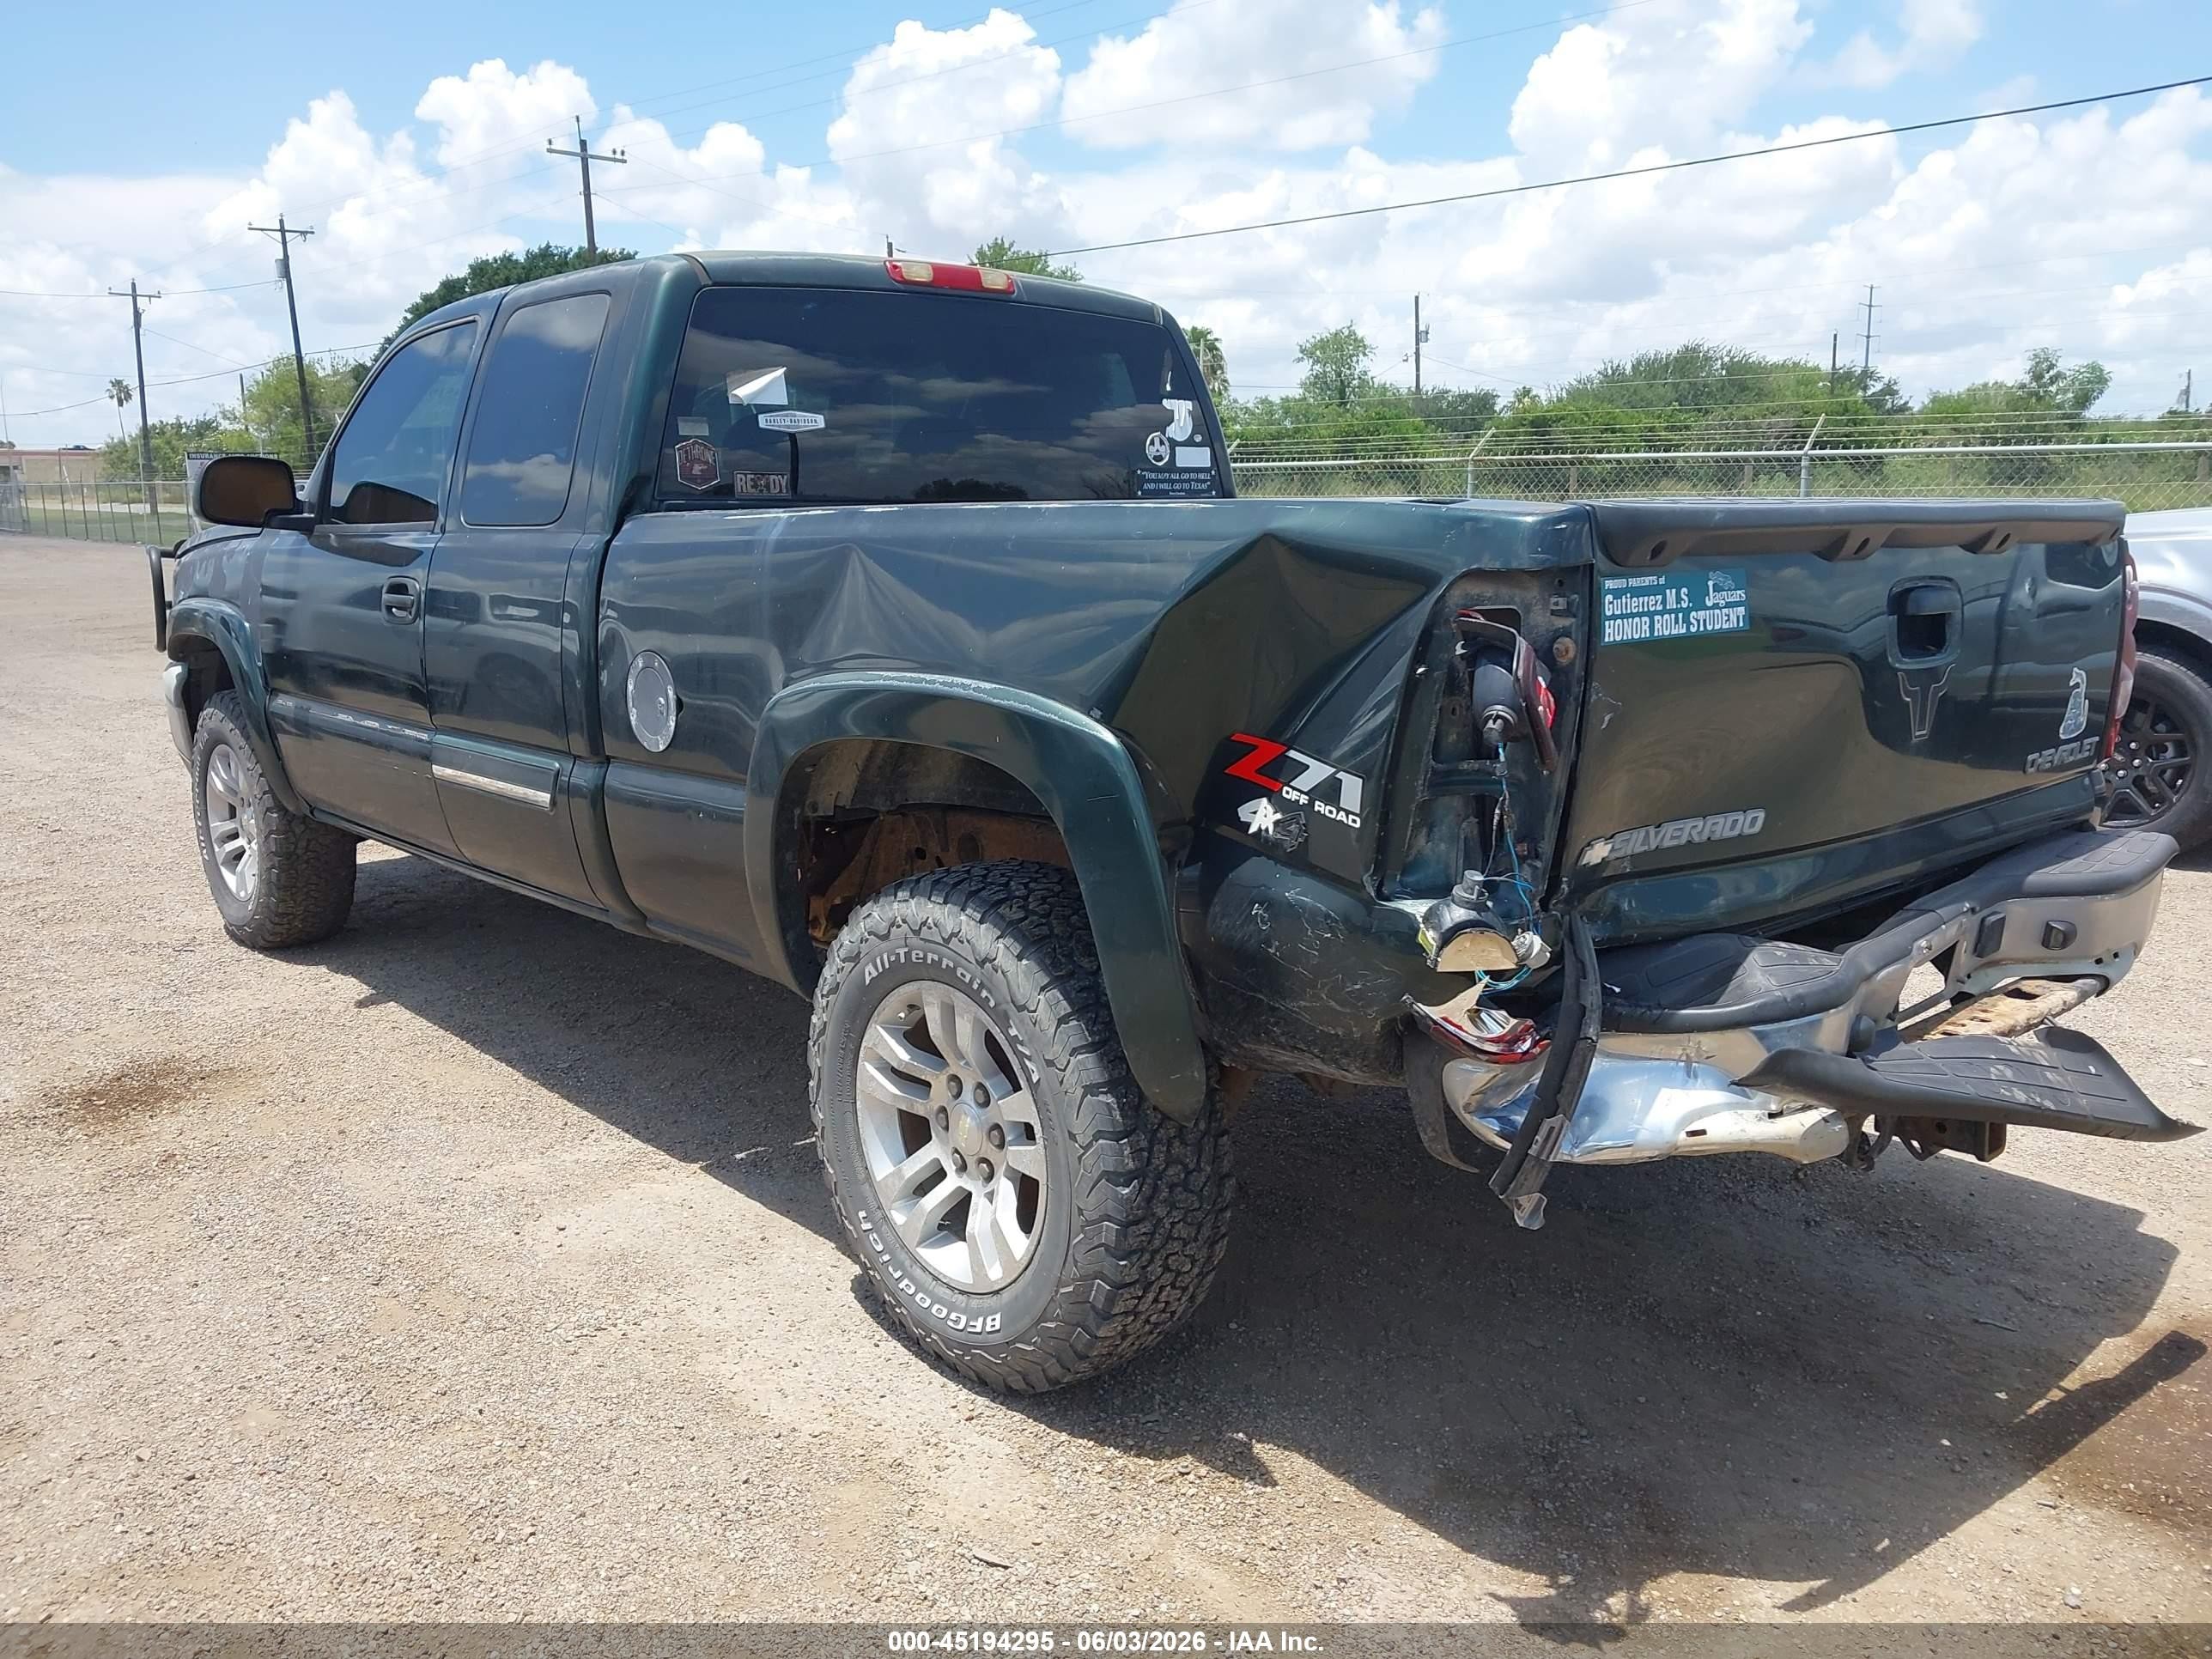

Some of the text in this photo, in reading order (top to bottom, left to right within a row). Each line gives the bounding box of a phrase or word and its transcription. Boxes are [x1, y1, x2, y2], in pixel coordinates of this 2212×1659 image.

[678, 445, 716, 465] DETHRONE
[1605, 579, 1627, 589] PROUD
[1628, 576, 1657, 587] PARENTS
[1605, 587, 1692, 616] Gutierrez M.S.
[1705, 580, 1746, 606] Jaguars
[1604, 606, 1745, 642] HONOR ROLL STUDENT
[1224, 732, 1364, 814] Z71
[1281, 786, 1361, 829] OFF ROAD
[1608, 808, 1765, 860] SILVERADO
[864, 947, 1040, 1084] All-Terrain T/A
[858, 1210, 1002, 1333] BFGoodrich
